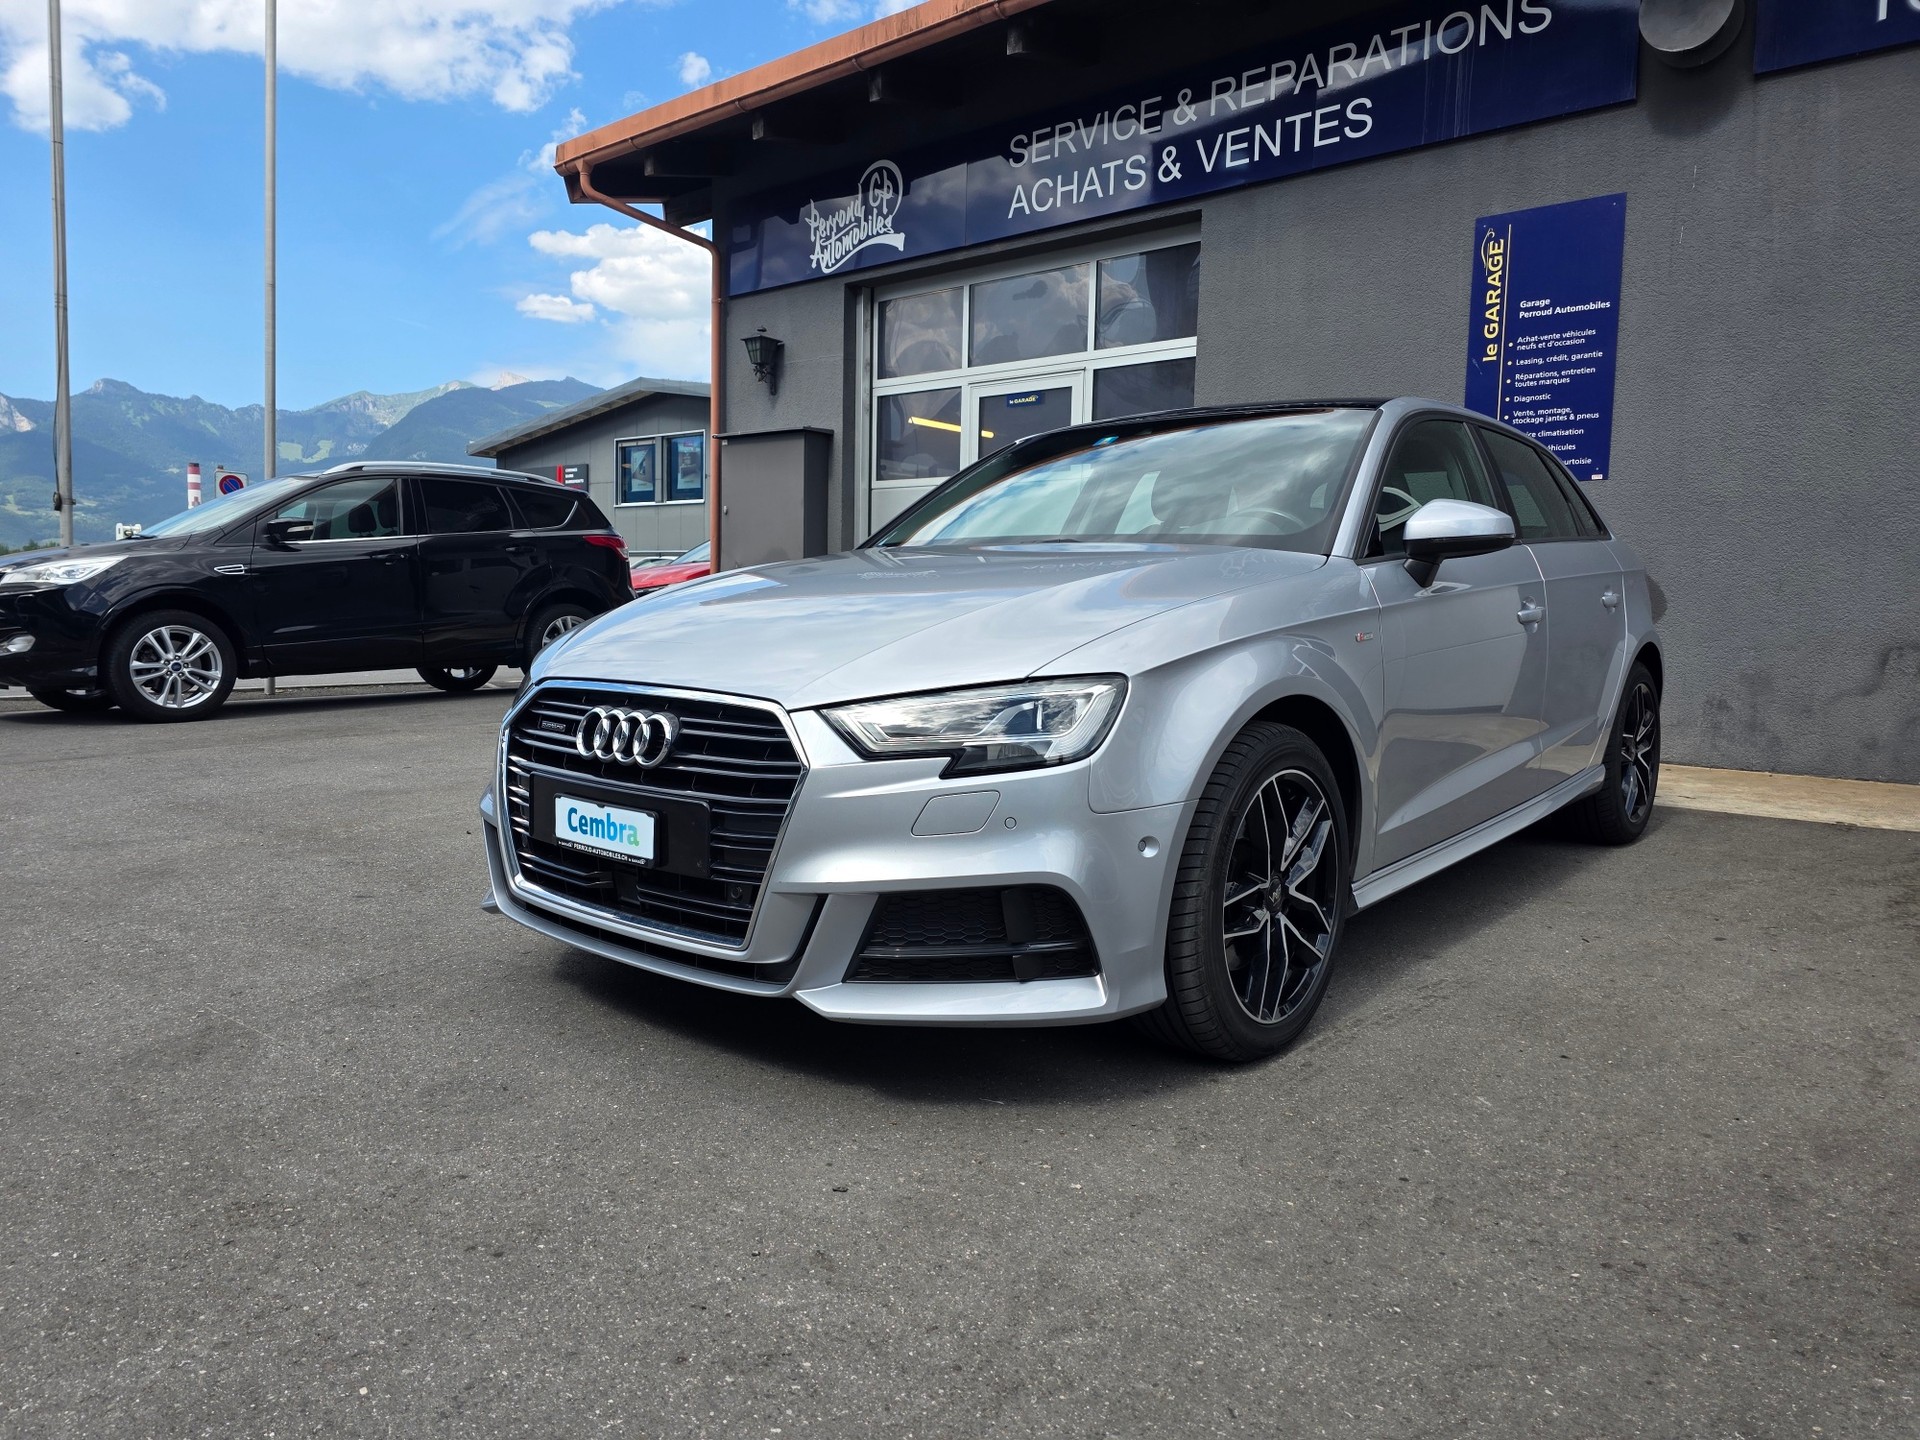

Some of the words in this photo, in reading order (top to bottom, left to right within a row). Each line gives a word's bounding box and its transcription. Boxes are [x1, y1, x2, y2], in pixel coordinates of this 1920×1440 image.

[1009, 96, 1162, 168] SERVICE
[1173, 88, 1197, 126] &
[1210, 0, 1552, 117] REPARATIONS
[1008, 154, 1147, 219] ACHATS
[1158, 146, 1182, 183] &
[1196, 98, 1373, 173] VENTES
[810, 207, 894, 269] Automobiles
[1484, 239, 1504, 339] GARAGE
[1519, 307, 1552, 319] Perroud
[1554, 301, 1610, 314] Automobiles
[1520, 299, 1551, 308] Garage
[1517, 332, 1560, 343] Achat-vente
[1562, 328, 1596, 338] véhicules
[1483, 343, 1498, 362] le
[1517, 342, 1536, 351] neufs
[1516, 357, 1544, 366] Leasing,
[1546, 354, 1569, 363] crédit,
[1571, 350, 1603, 361] garantie
[1515, 371, 1559, 381] Réparations,
[1561, 367, 1596, 376] entretien
[1515, 380, 1537, 388] toutes
[1538, 377, 1570, 386] marques
[1513, 393, 1551, 403] Diagnostic
[1512, 416, 1544, 425] stockage
[1544, 414, 1567, 424] jantes
[1576, 412, 1599, 421] pneus
[1537, 428, 1584, 438] climatisation
[567, 807, 640, 847] Cembra
